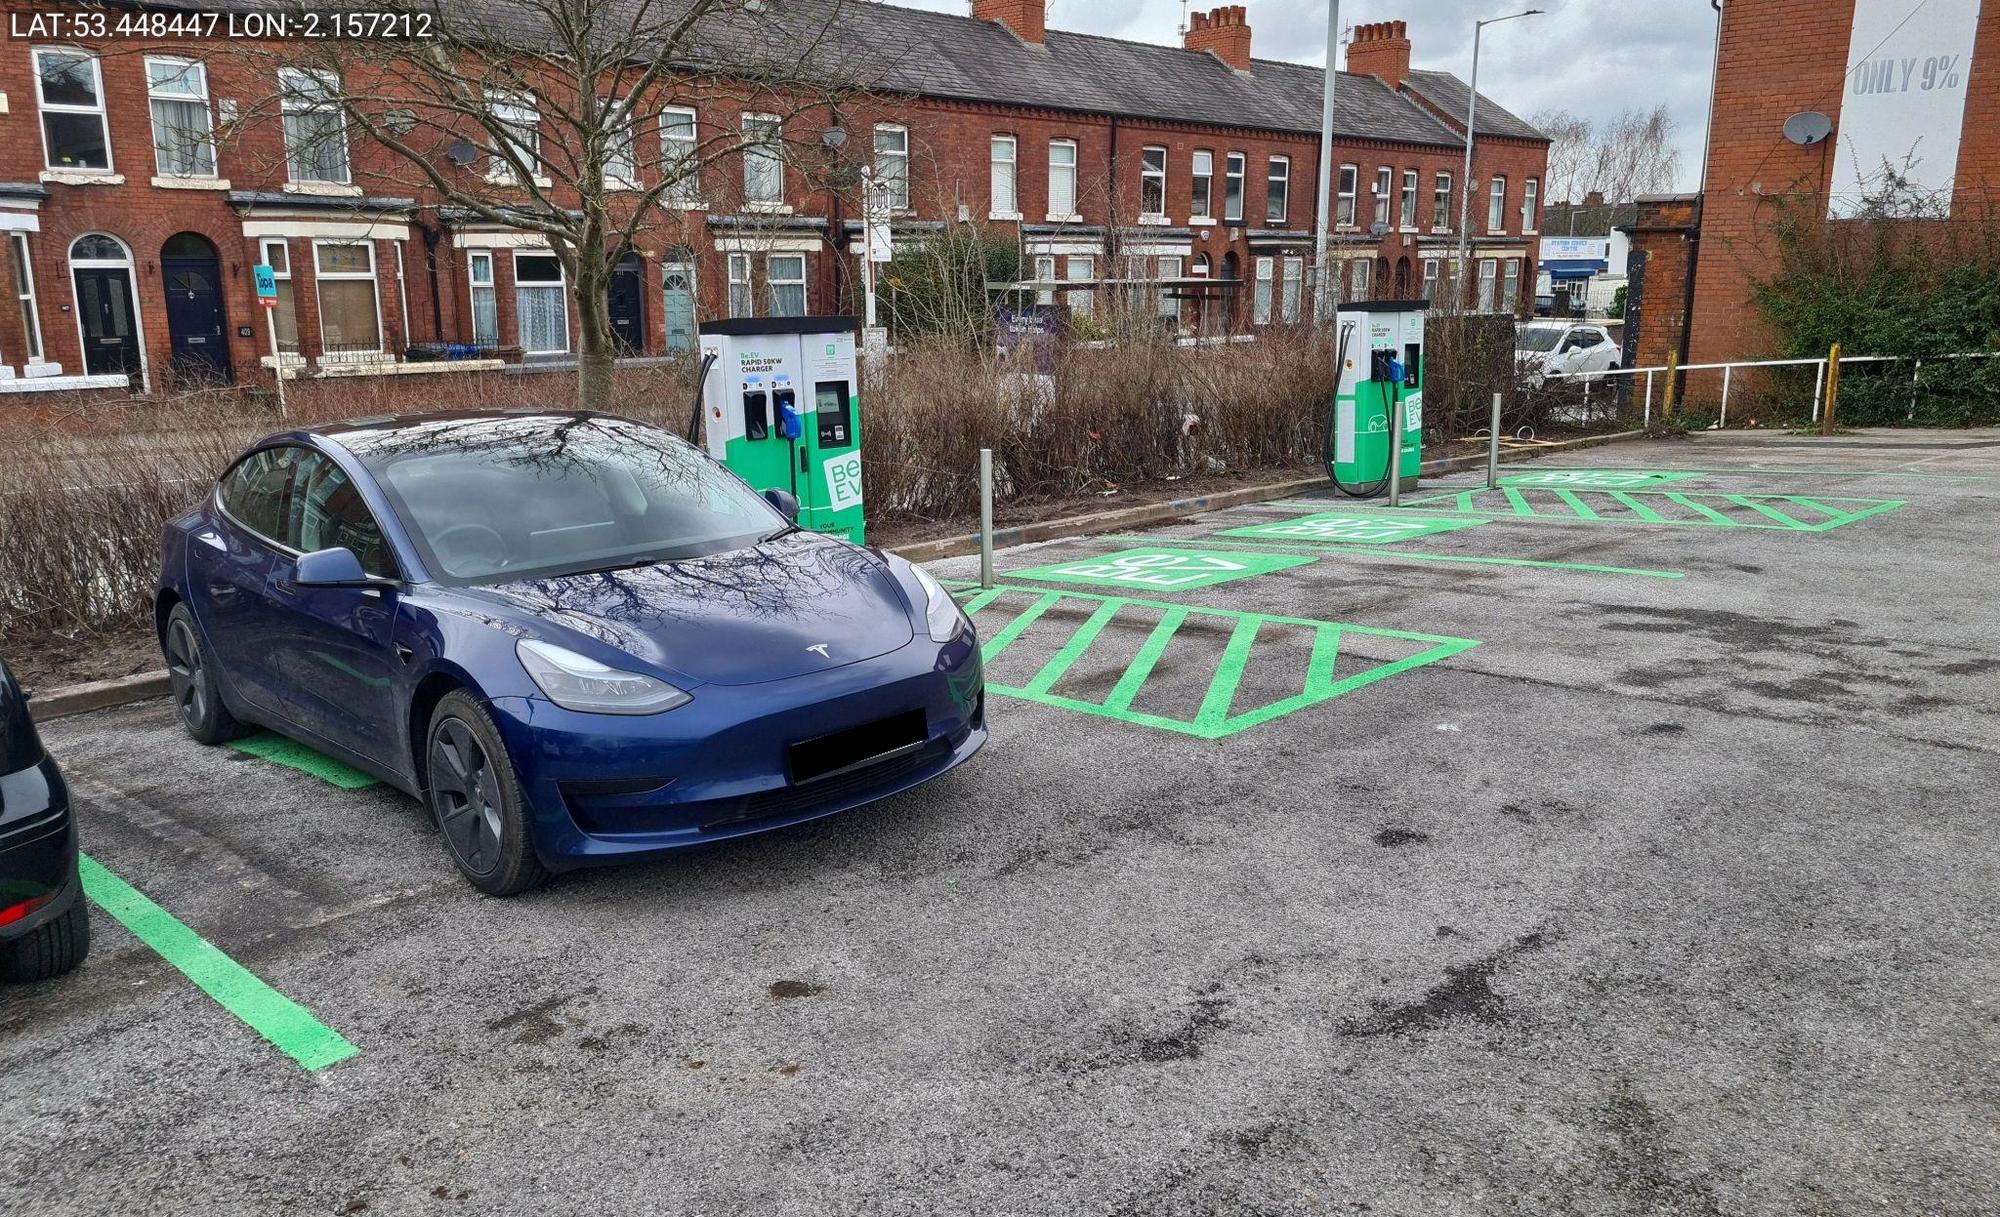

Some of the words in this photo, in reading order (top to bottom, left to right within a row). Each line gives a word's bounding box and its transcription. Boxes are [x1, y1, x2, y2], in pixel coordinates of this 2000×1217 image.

[1853, 58, 1917, 95] ONLY
[1920, 54, 1960, 91] 9%
[742, 365, 773, 373] CHARGER
[831, 459, 860, 484] Be
